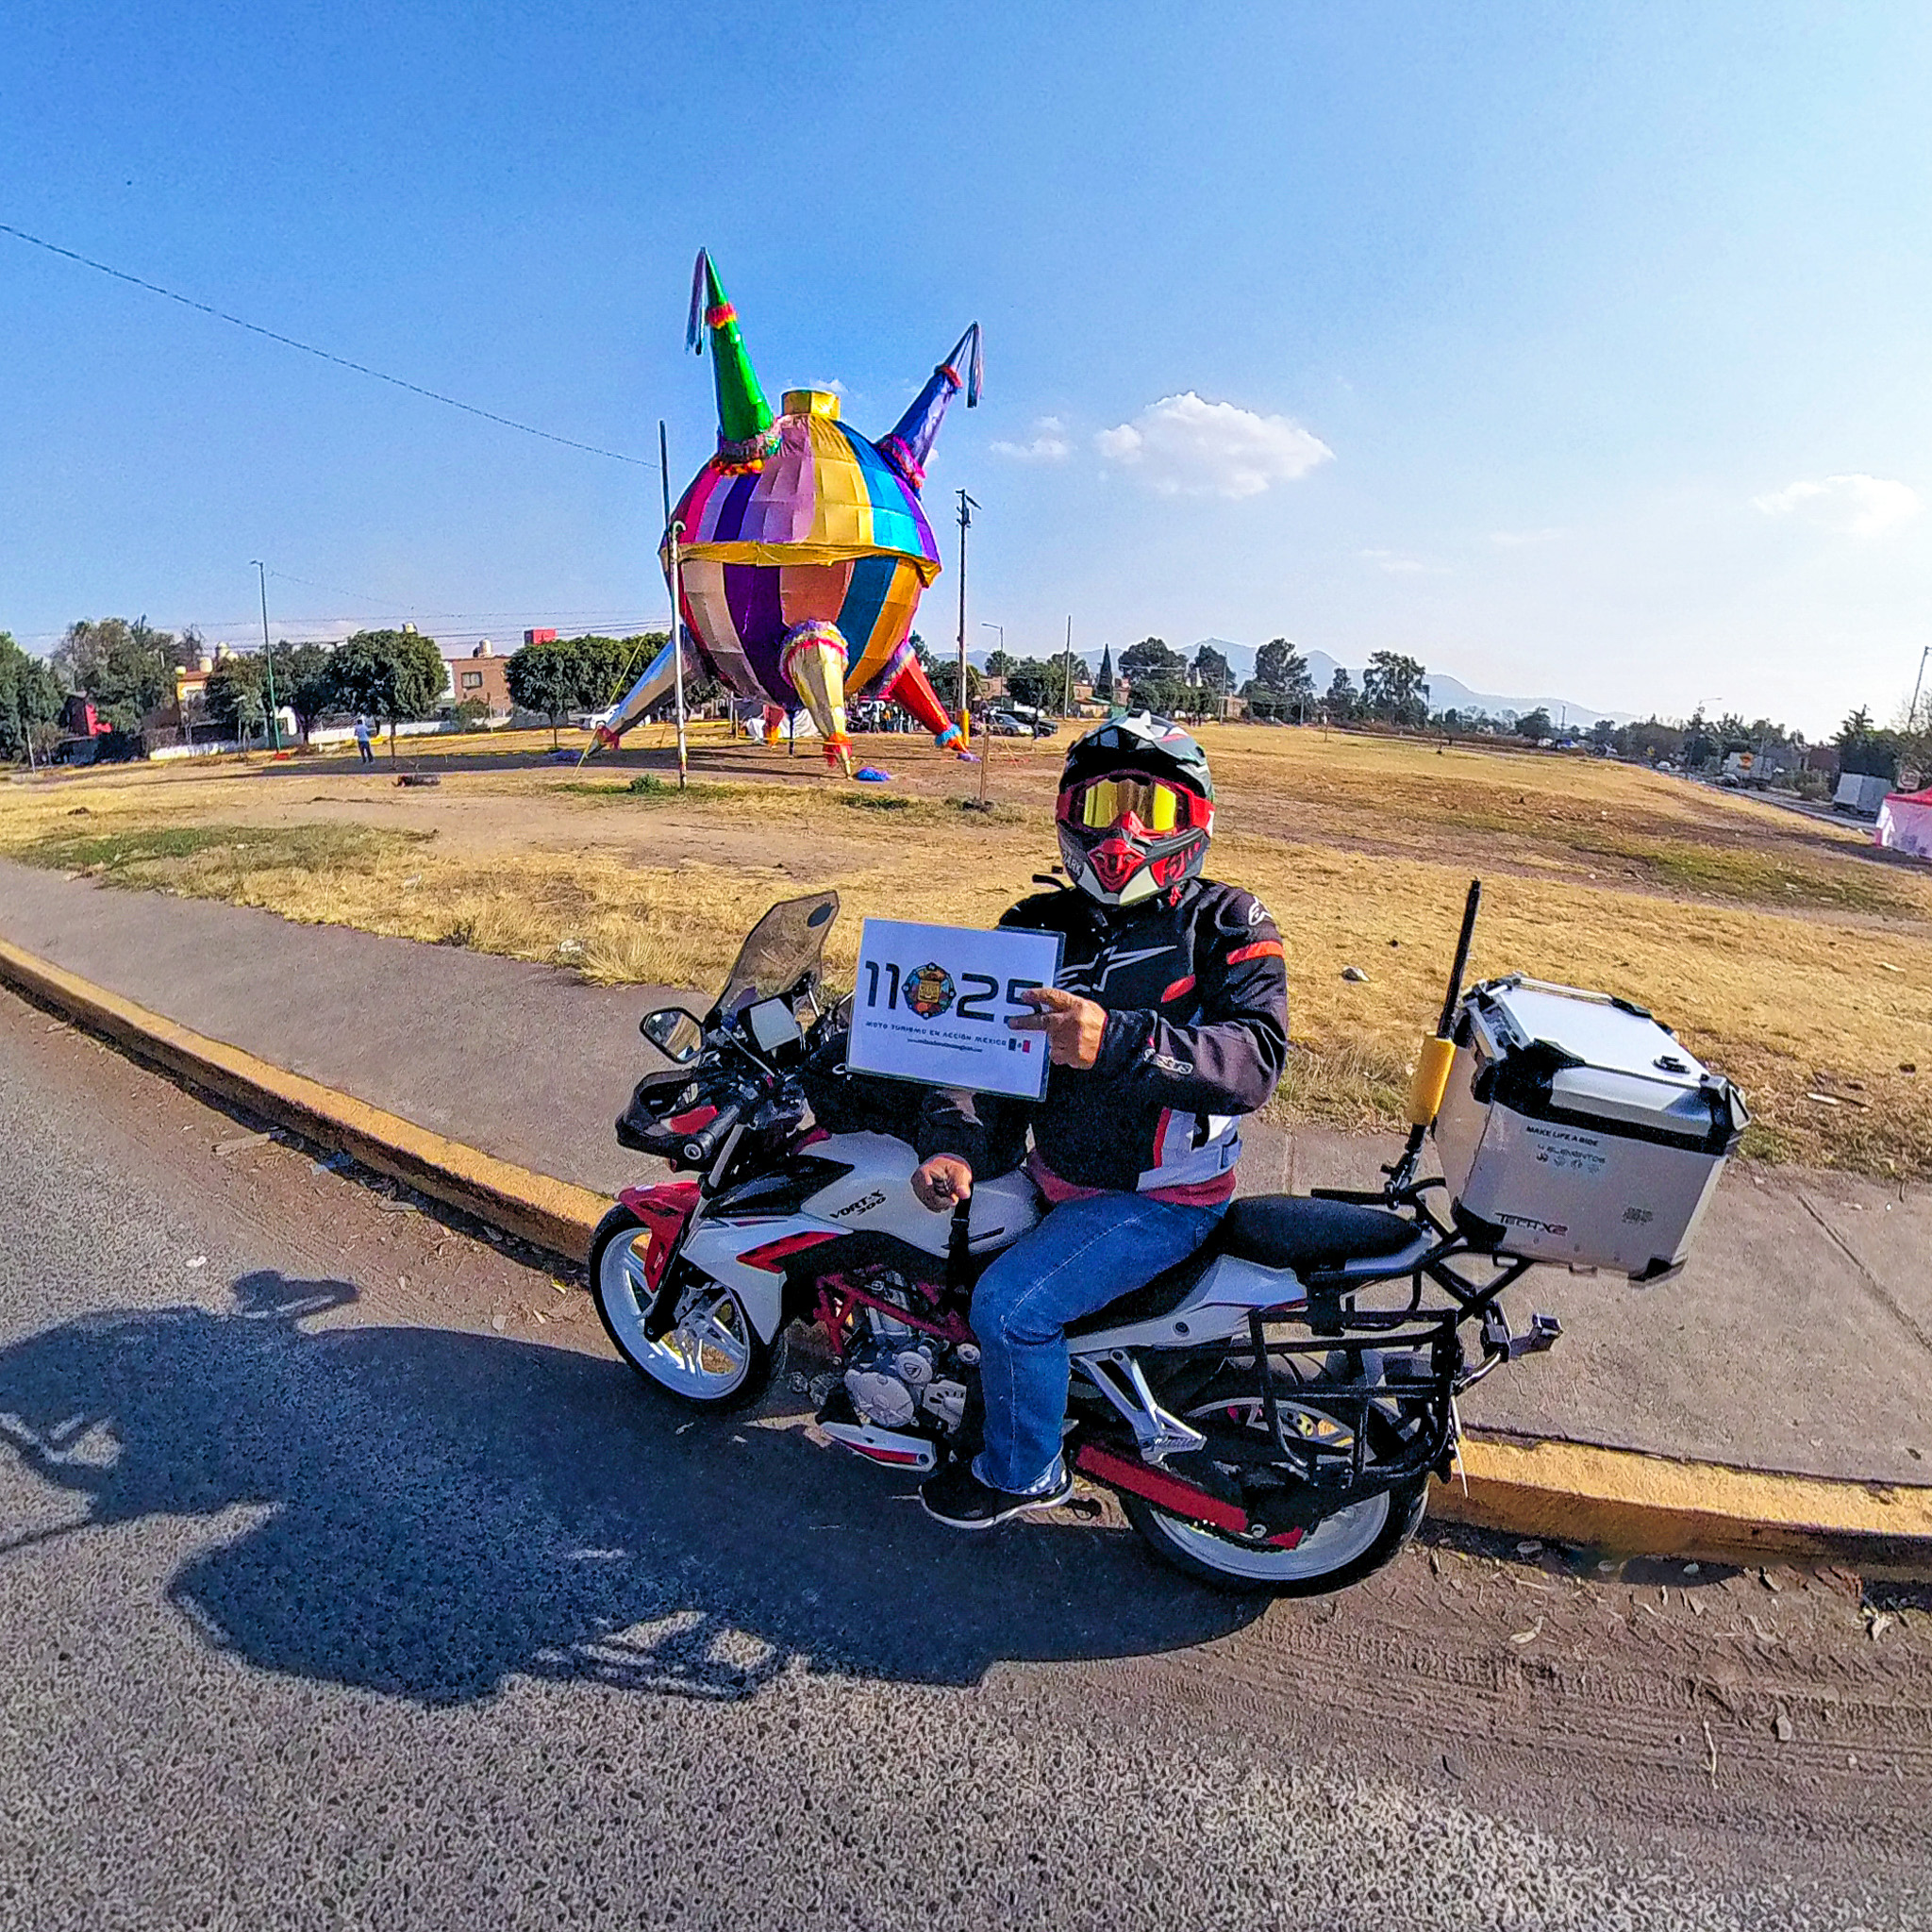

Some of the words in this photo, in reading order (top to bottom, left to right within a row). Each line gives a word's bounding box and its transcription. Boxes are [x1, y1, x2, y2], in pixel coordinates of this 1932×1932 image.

[865, 1021, 888, 1029] MOTO
[1526, 1125, 1551, 1137] MAKE
[1552, 1131, 1571, 1141] LIFE
